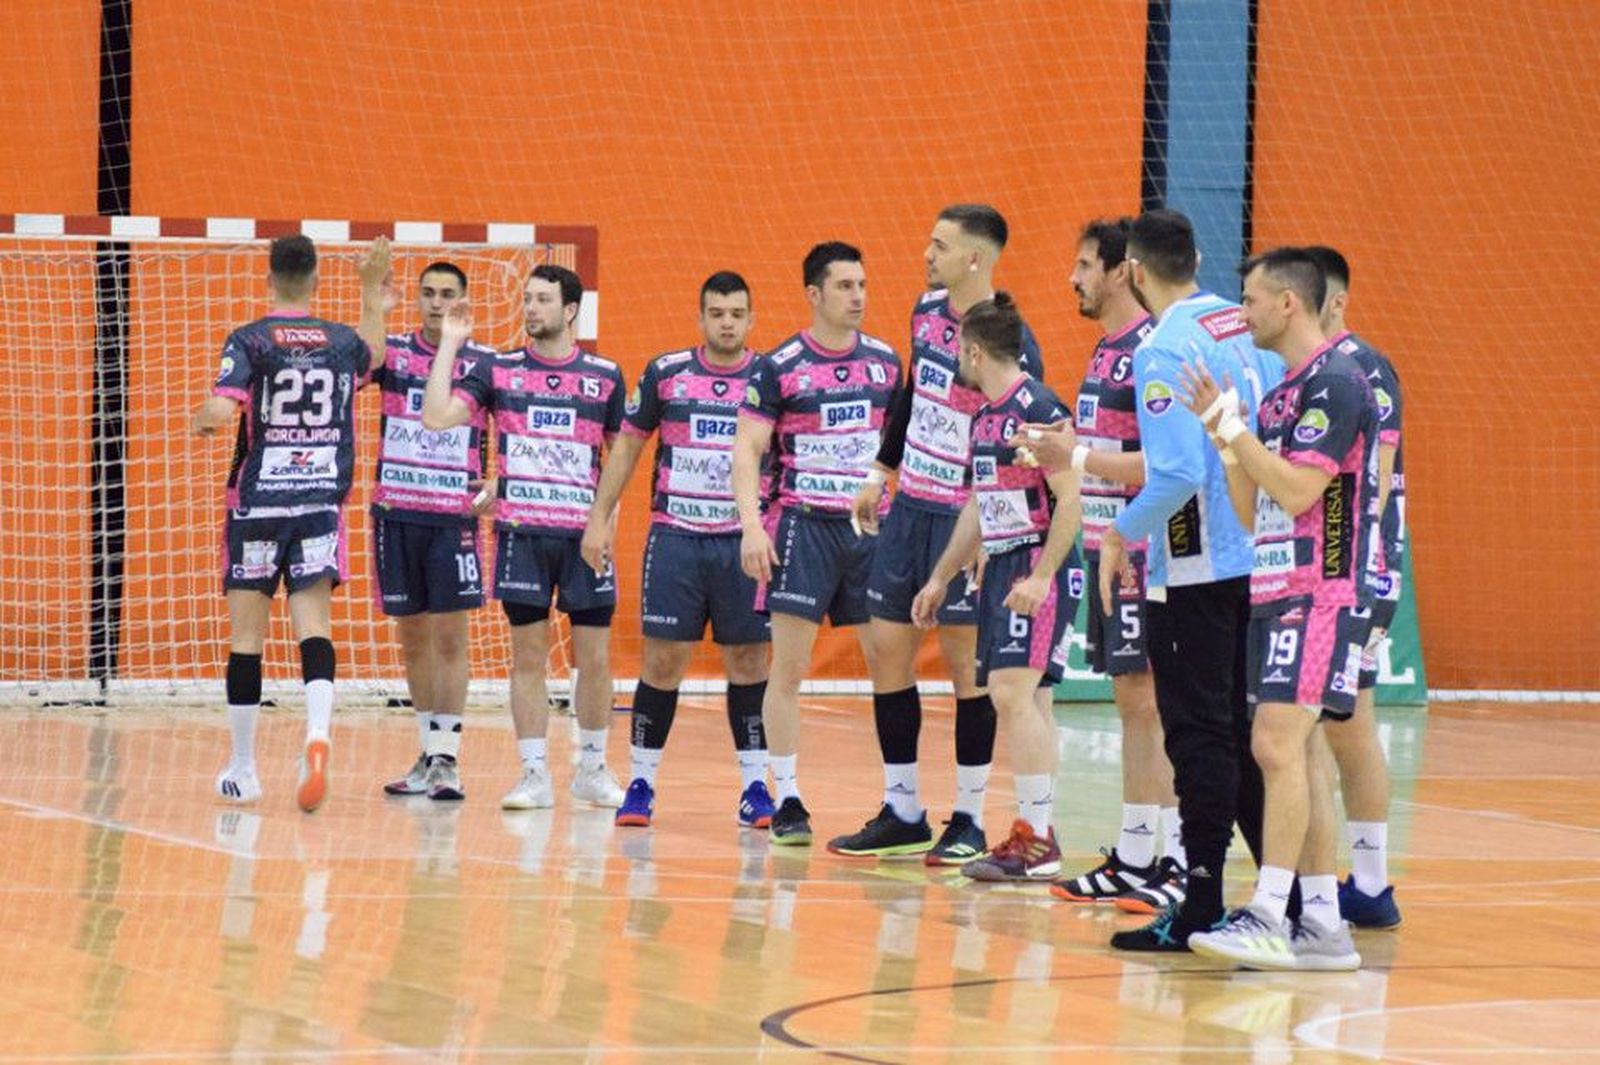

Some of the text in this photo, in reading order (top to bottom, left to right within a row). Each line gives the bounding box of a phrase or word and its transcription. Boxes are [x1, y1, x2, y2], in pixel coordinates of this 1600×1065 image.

[868, 363, 887, 384] 10
[920, 365, 947, 389] gaza
[1114, 356, 1131, 381] 5
[270, 369, 334, 426] 23
[582, 377, 601, 397] 15
[533, 411, 571, 429] gaza
[827, 405, 866, 427] gaza
[697, 420, 737, 438] gaza
[1003, 418, 1015, 440] 6
[383, 468, 414, 482] CAJA
[455, 553, 479, 583] 18
[1009, 609, 1028, 638] 6
[1121, 604, 1140, 639] 5
[1266, 628, 1298, 666] 19
